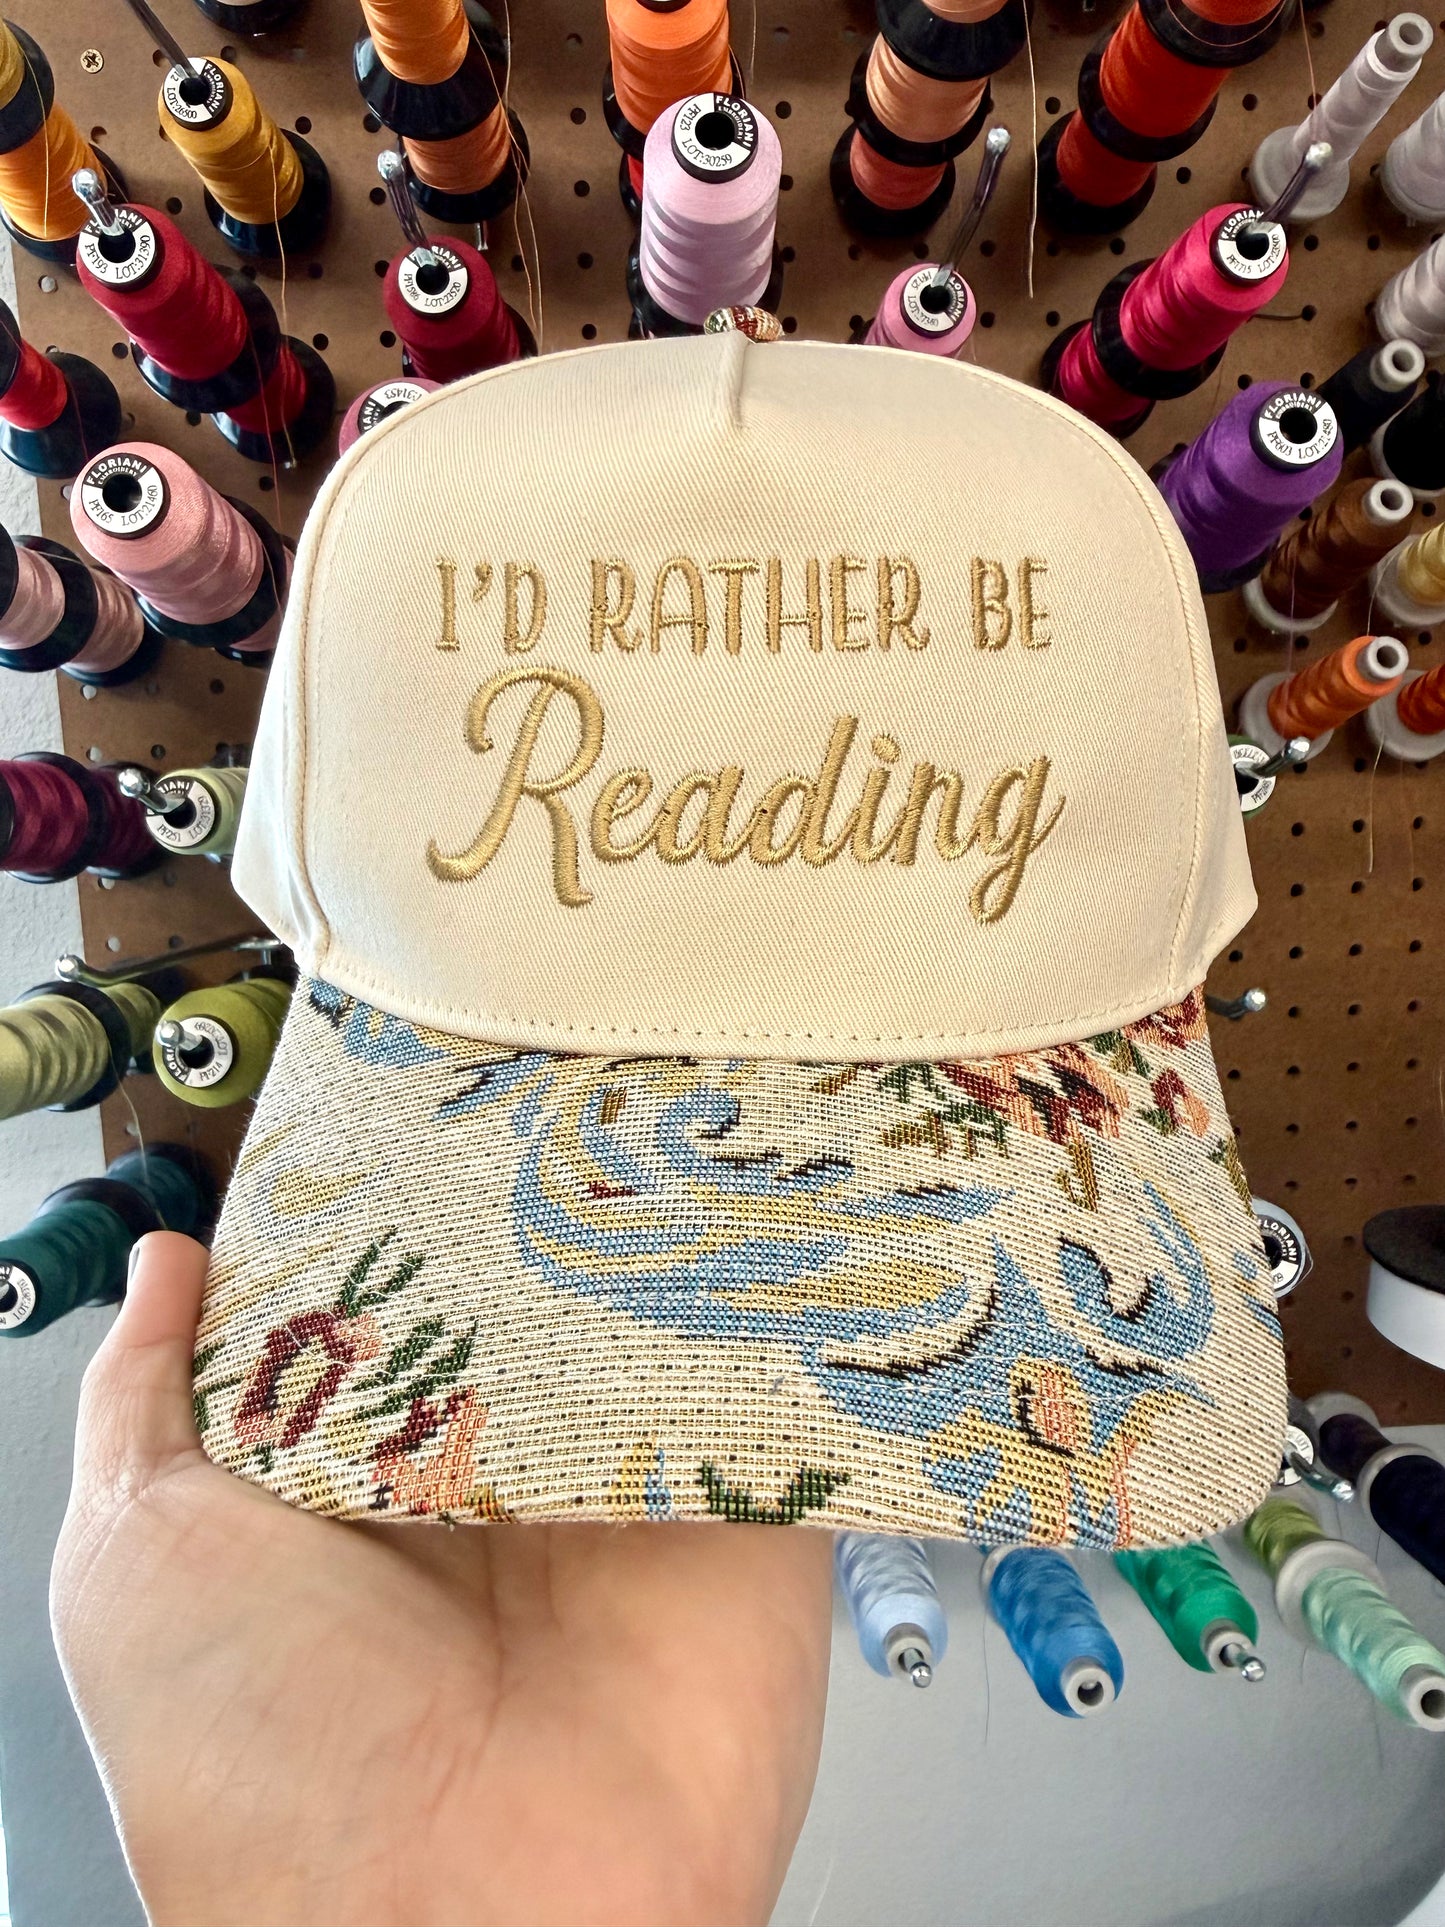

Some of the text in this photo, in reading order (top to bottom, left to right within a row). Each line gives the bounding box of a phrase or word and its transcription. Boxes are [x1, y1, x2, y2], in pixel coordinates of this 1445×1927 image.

[205, 63, 225, 112] FLORIANI
[680, 103, 733, 168] PF123 LOT:30259
[716, 95, 755, 148] FLORIANI
[84, 208, 143, 234] FLIANI
[1221, 209, 1265, 240] FLORIAN
[84, 235, 151, 280] PF193 LOT:31390
[408, 245, 462, 269] FRIANI
[949, 276, 965, 322] LORIANI
[1264, 392, 1322, 419] FLORIANI
[86, 457, 147, 485] FLORIANI
[88, 499, 114, 524] PF165
[435, 556, 1052, 655] I'D RATHER BE
[427, 664, 1066, 925] Reading
[166, 1048, 188, 1082] FLORI
